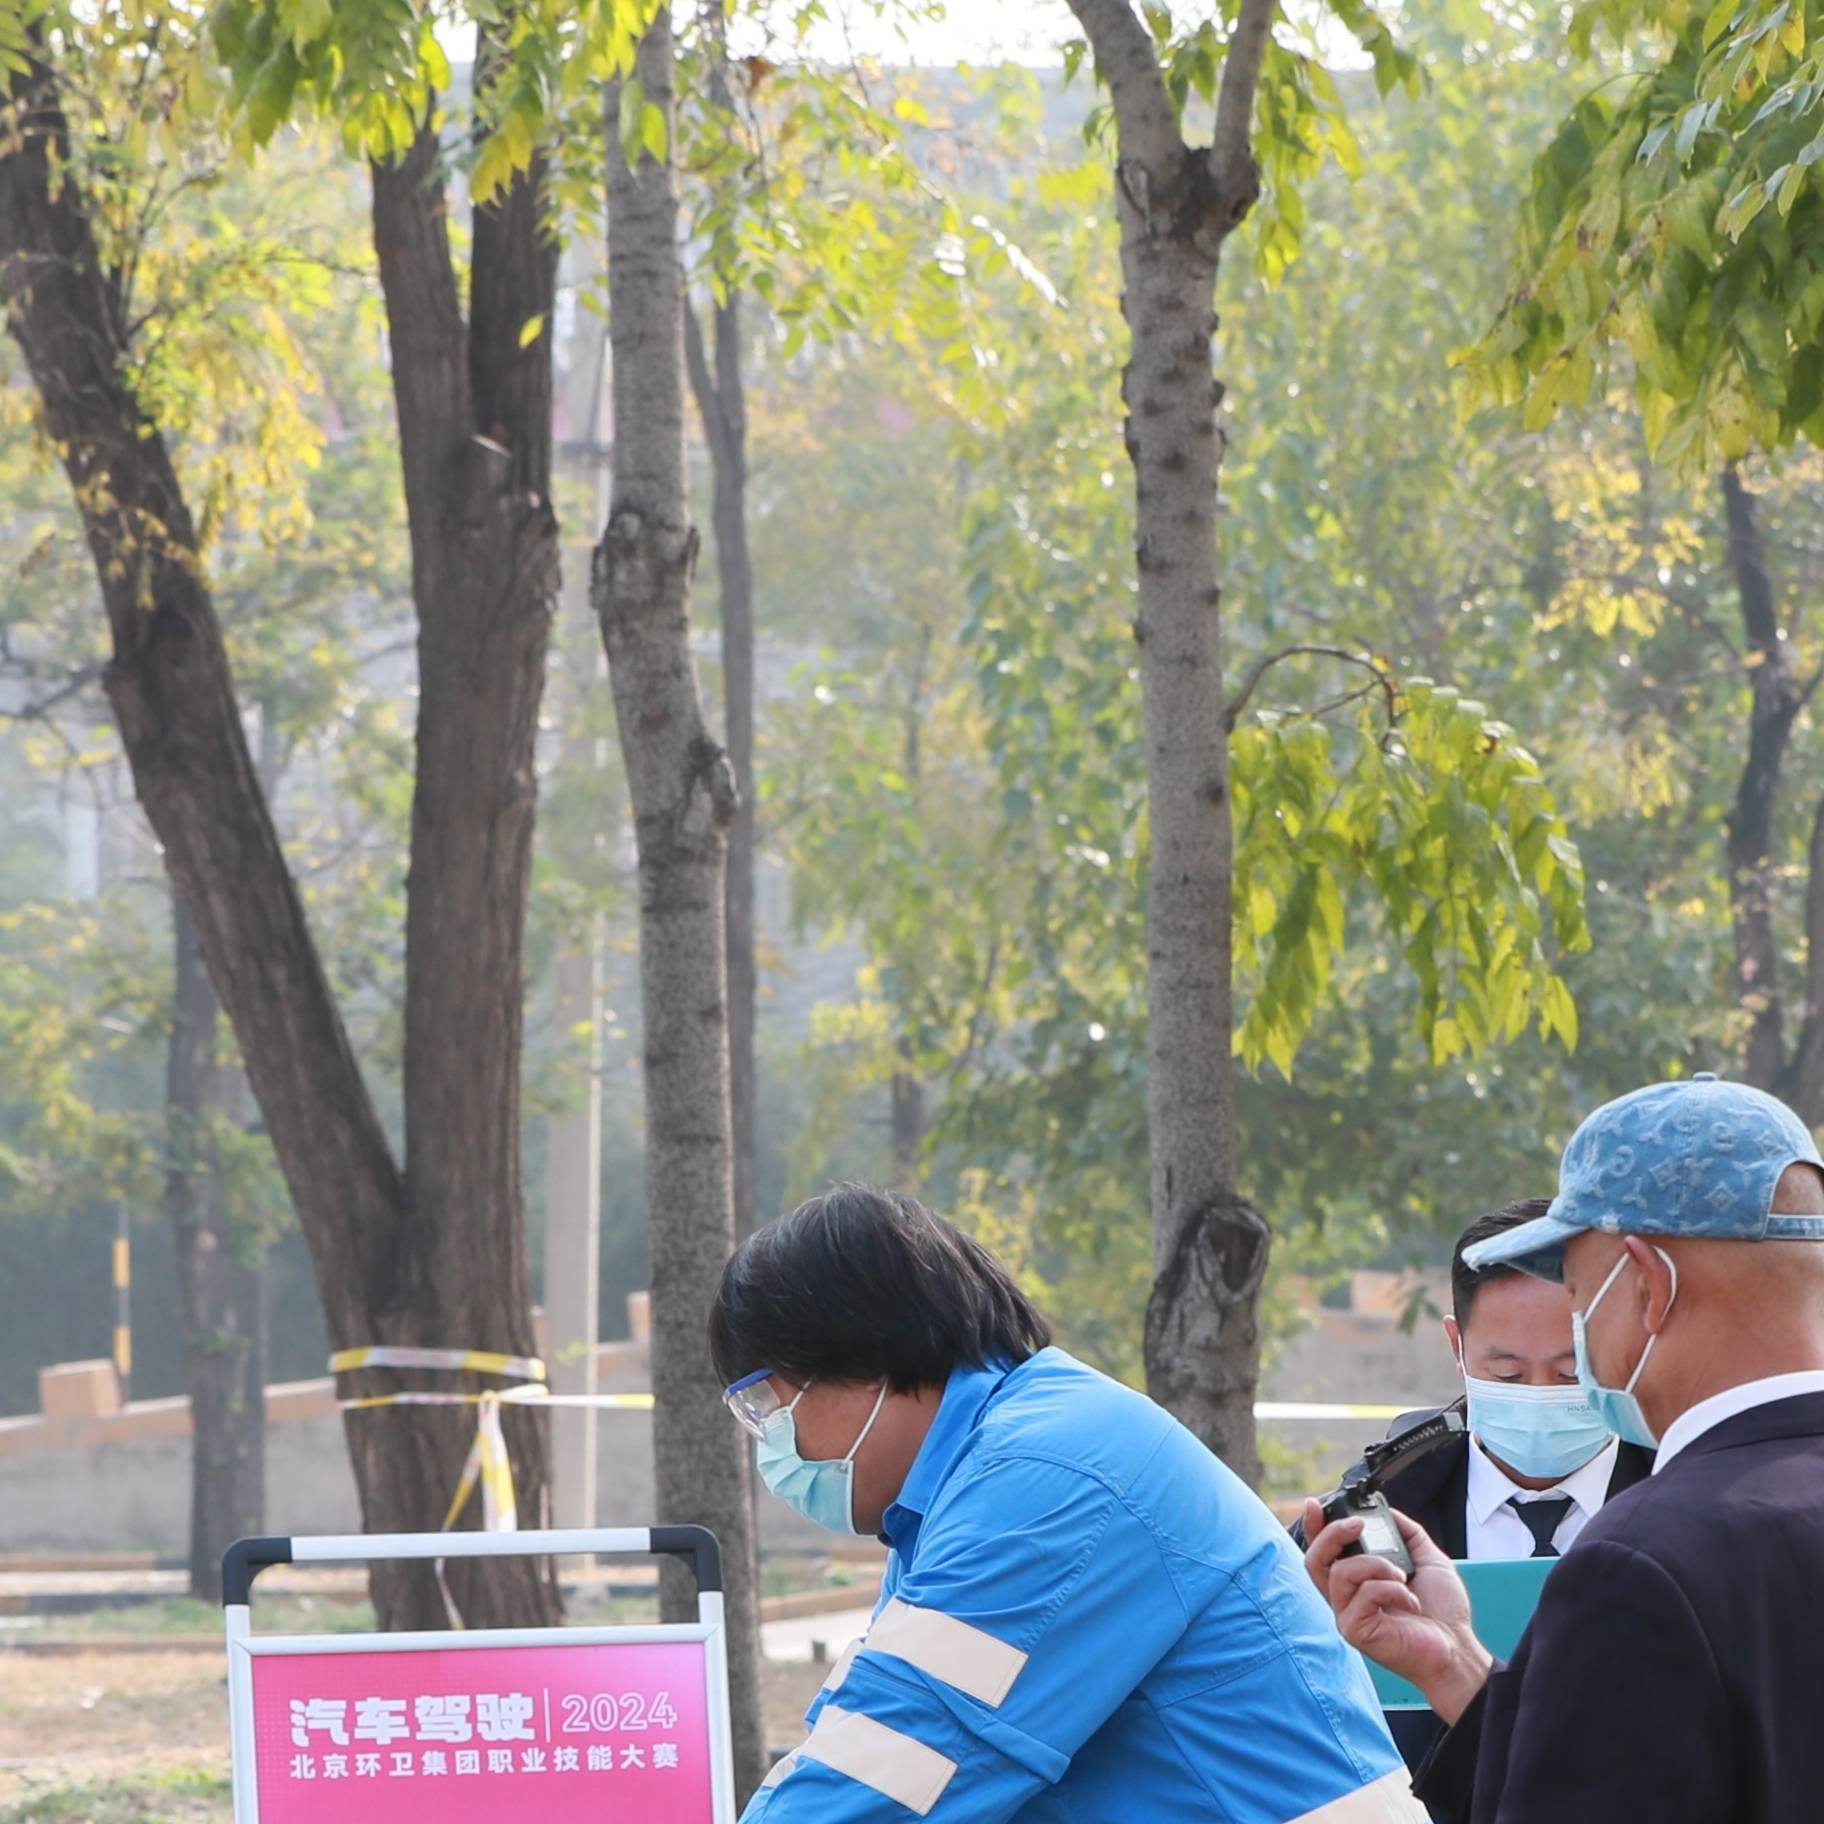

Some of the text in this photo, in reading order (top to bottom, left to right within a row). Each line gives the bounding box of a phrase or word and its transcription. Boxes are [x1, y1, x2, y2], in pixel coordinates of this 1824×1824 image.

[289, 1691, 678, 1747] 汽车驾驶 2024
[289, 1742, 679, 1780] 北京环卫集团职业技能大赛
